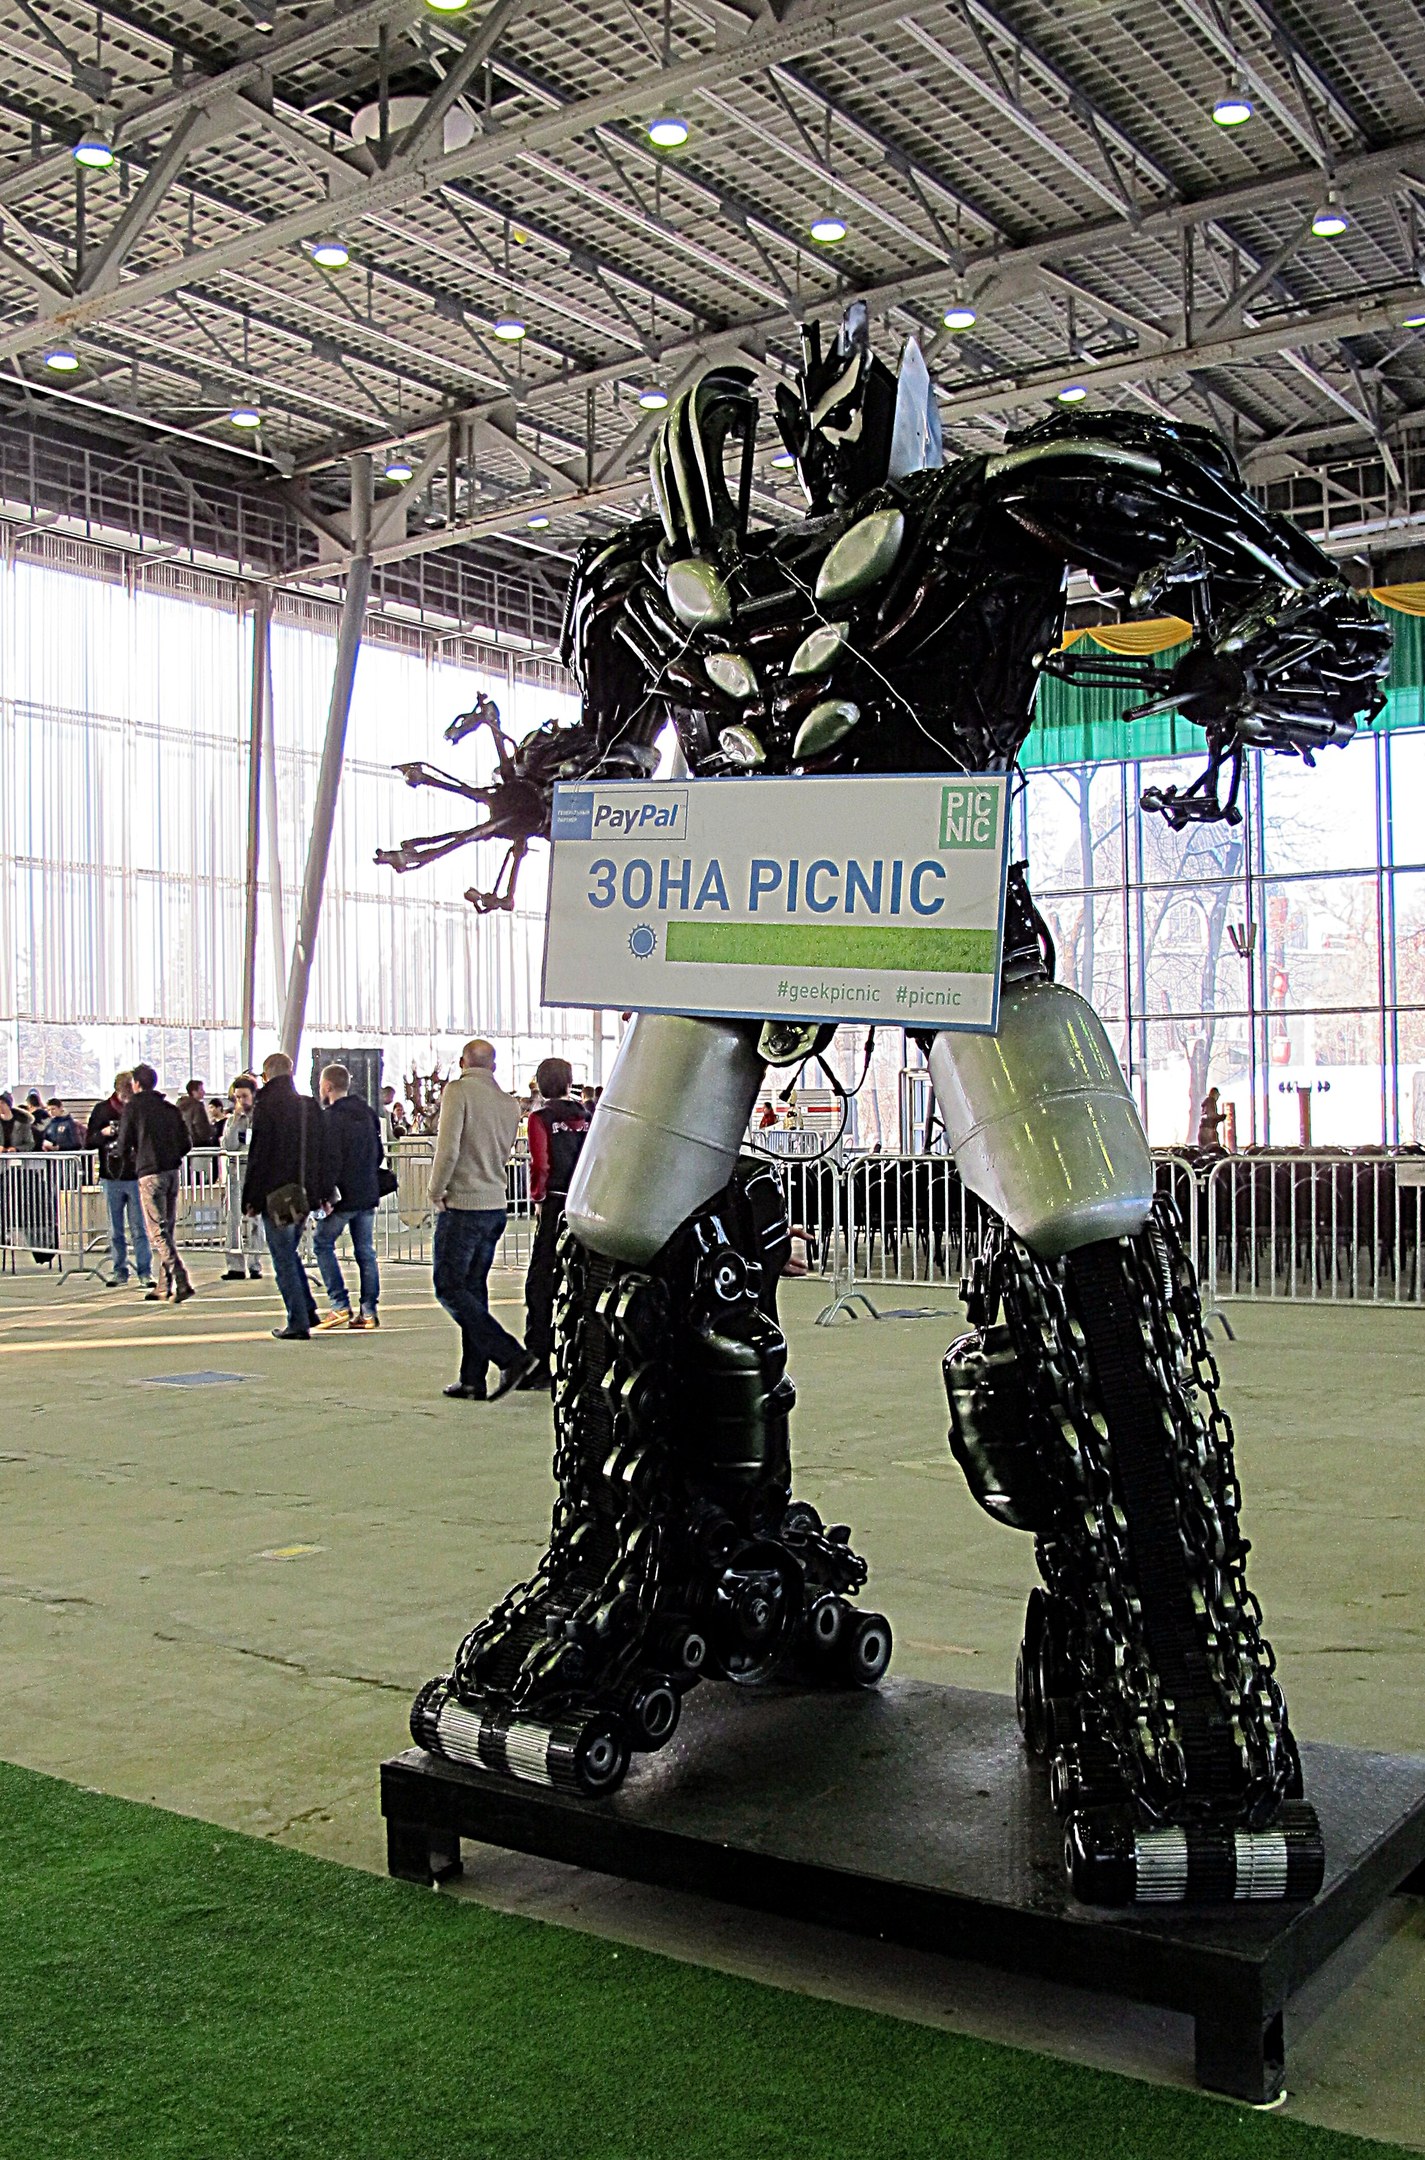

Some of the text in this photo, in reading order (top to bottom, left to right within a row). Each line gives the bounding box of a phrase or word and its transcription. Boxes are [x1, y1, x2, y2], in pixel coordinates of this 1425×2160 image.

[947, 792, 991, 817] PIC
[594, 804, 679, 834] PayPal
[946, 817, 990, 842] NIC
[748, 859, 947, 915] PICNIC
[777, 981, 962, 1006] #geekpicnic #picnic
